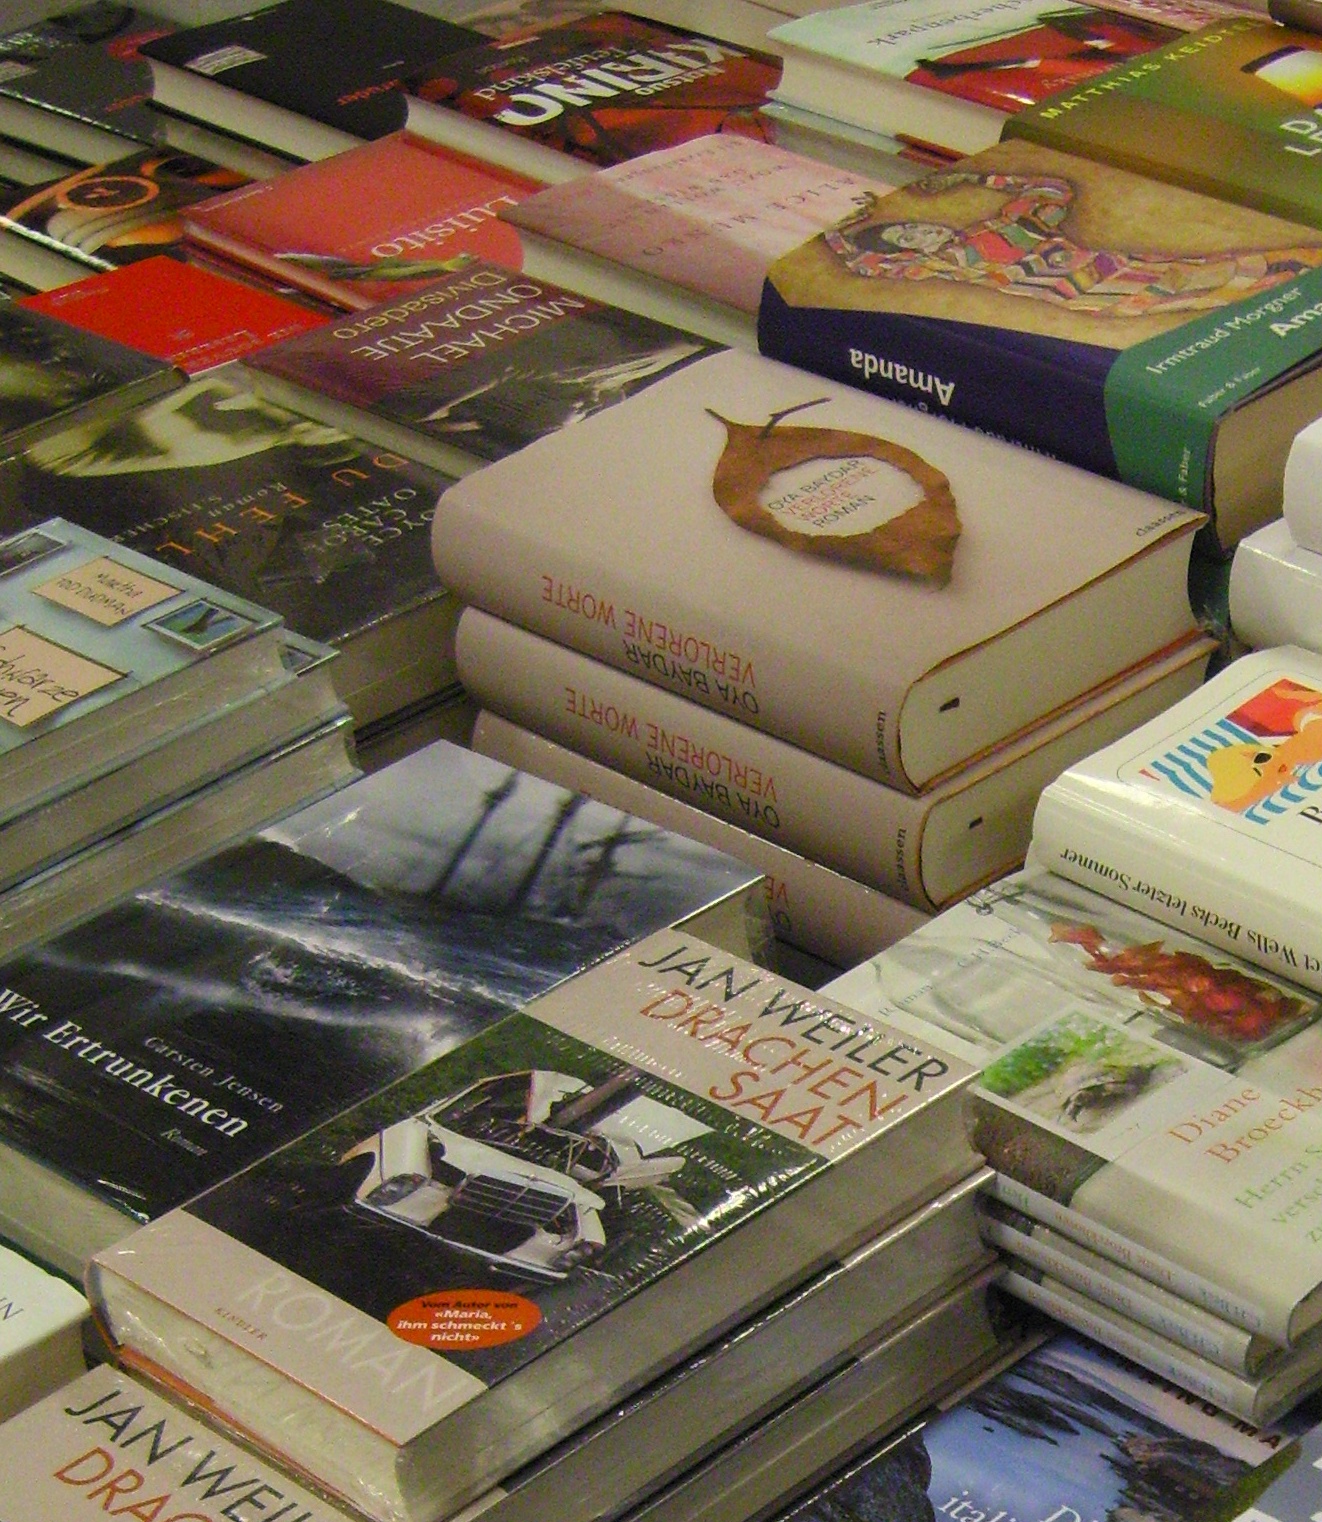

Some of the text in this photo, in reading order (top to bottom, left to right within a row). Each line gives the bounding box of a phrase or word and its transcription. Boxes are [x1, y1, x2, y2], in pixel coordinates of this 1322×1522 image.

[492, 38, 726, 127] KIRINO
[1039, 58, 1161, 120] MATTHIAS
[370, 194, 519, 258] Luisito
[333, 271, 508, 340] Divisadero
[350, 284, 543, 361] ONDAATJE
[410, 297, 586, 363] MICHAEL
[1146, 286, 1303, 377] Irmtraud Morgner
[848, 347, 956, 407] Amanda
[331, 452, 411, 487] DU
[767, 489, 803, 513] OYA
[322, 489, 418, 530] OATES
[812, 494, 876, 530] ROMAN
[541, 574, 619, 631] WORTE
[622, 638, 760, 716] BAYDAR OYA
[623, 607, 756, 689] VERLORENE
[564, 685, 641, 742] WORTE
[644, 721, 779, 804] VERLORENE
[645, 750, 781, 830] BAYDAR OYA
[1059, 847, 1132, 892] Sommer
[1131, 877, 1188, 917] letzter
[1189, 903, 1243, 942] Becks
[1246, 929, 1299, 969] Wells
[638, 944, 761, 1004] JAN
[762, 986, 951, 1095] WEILER
[0, 987, 253, 1139] Wir Ertrunkenen
[142, 1035, 286, 1115] Carsten Jensen
[638, 987, 910, 1122] DRACHEN
[708, 1070, 864, 1148] SAAT
[1165, 1086, 1263, 1148] Diane
[1234, 1154, 1309, 1212] Herrn
[430, 1319, 508, 1332] schmeckt
[64, 1387, 195, 1467] JAN
